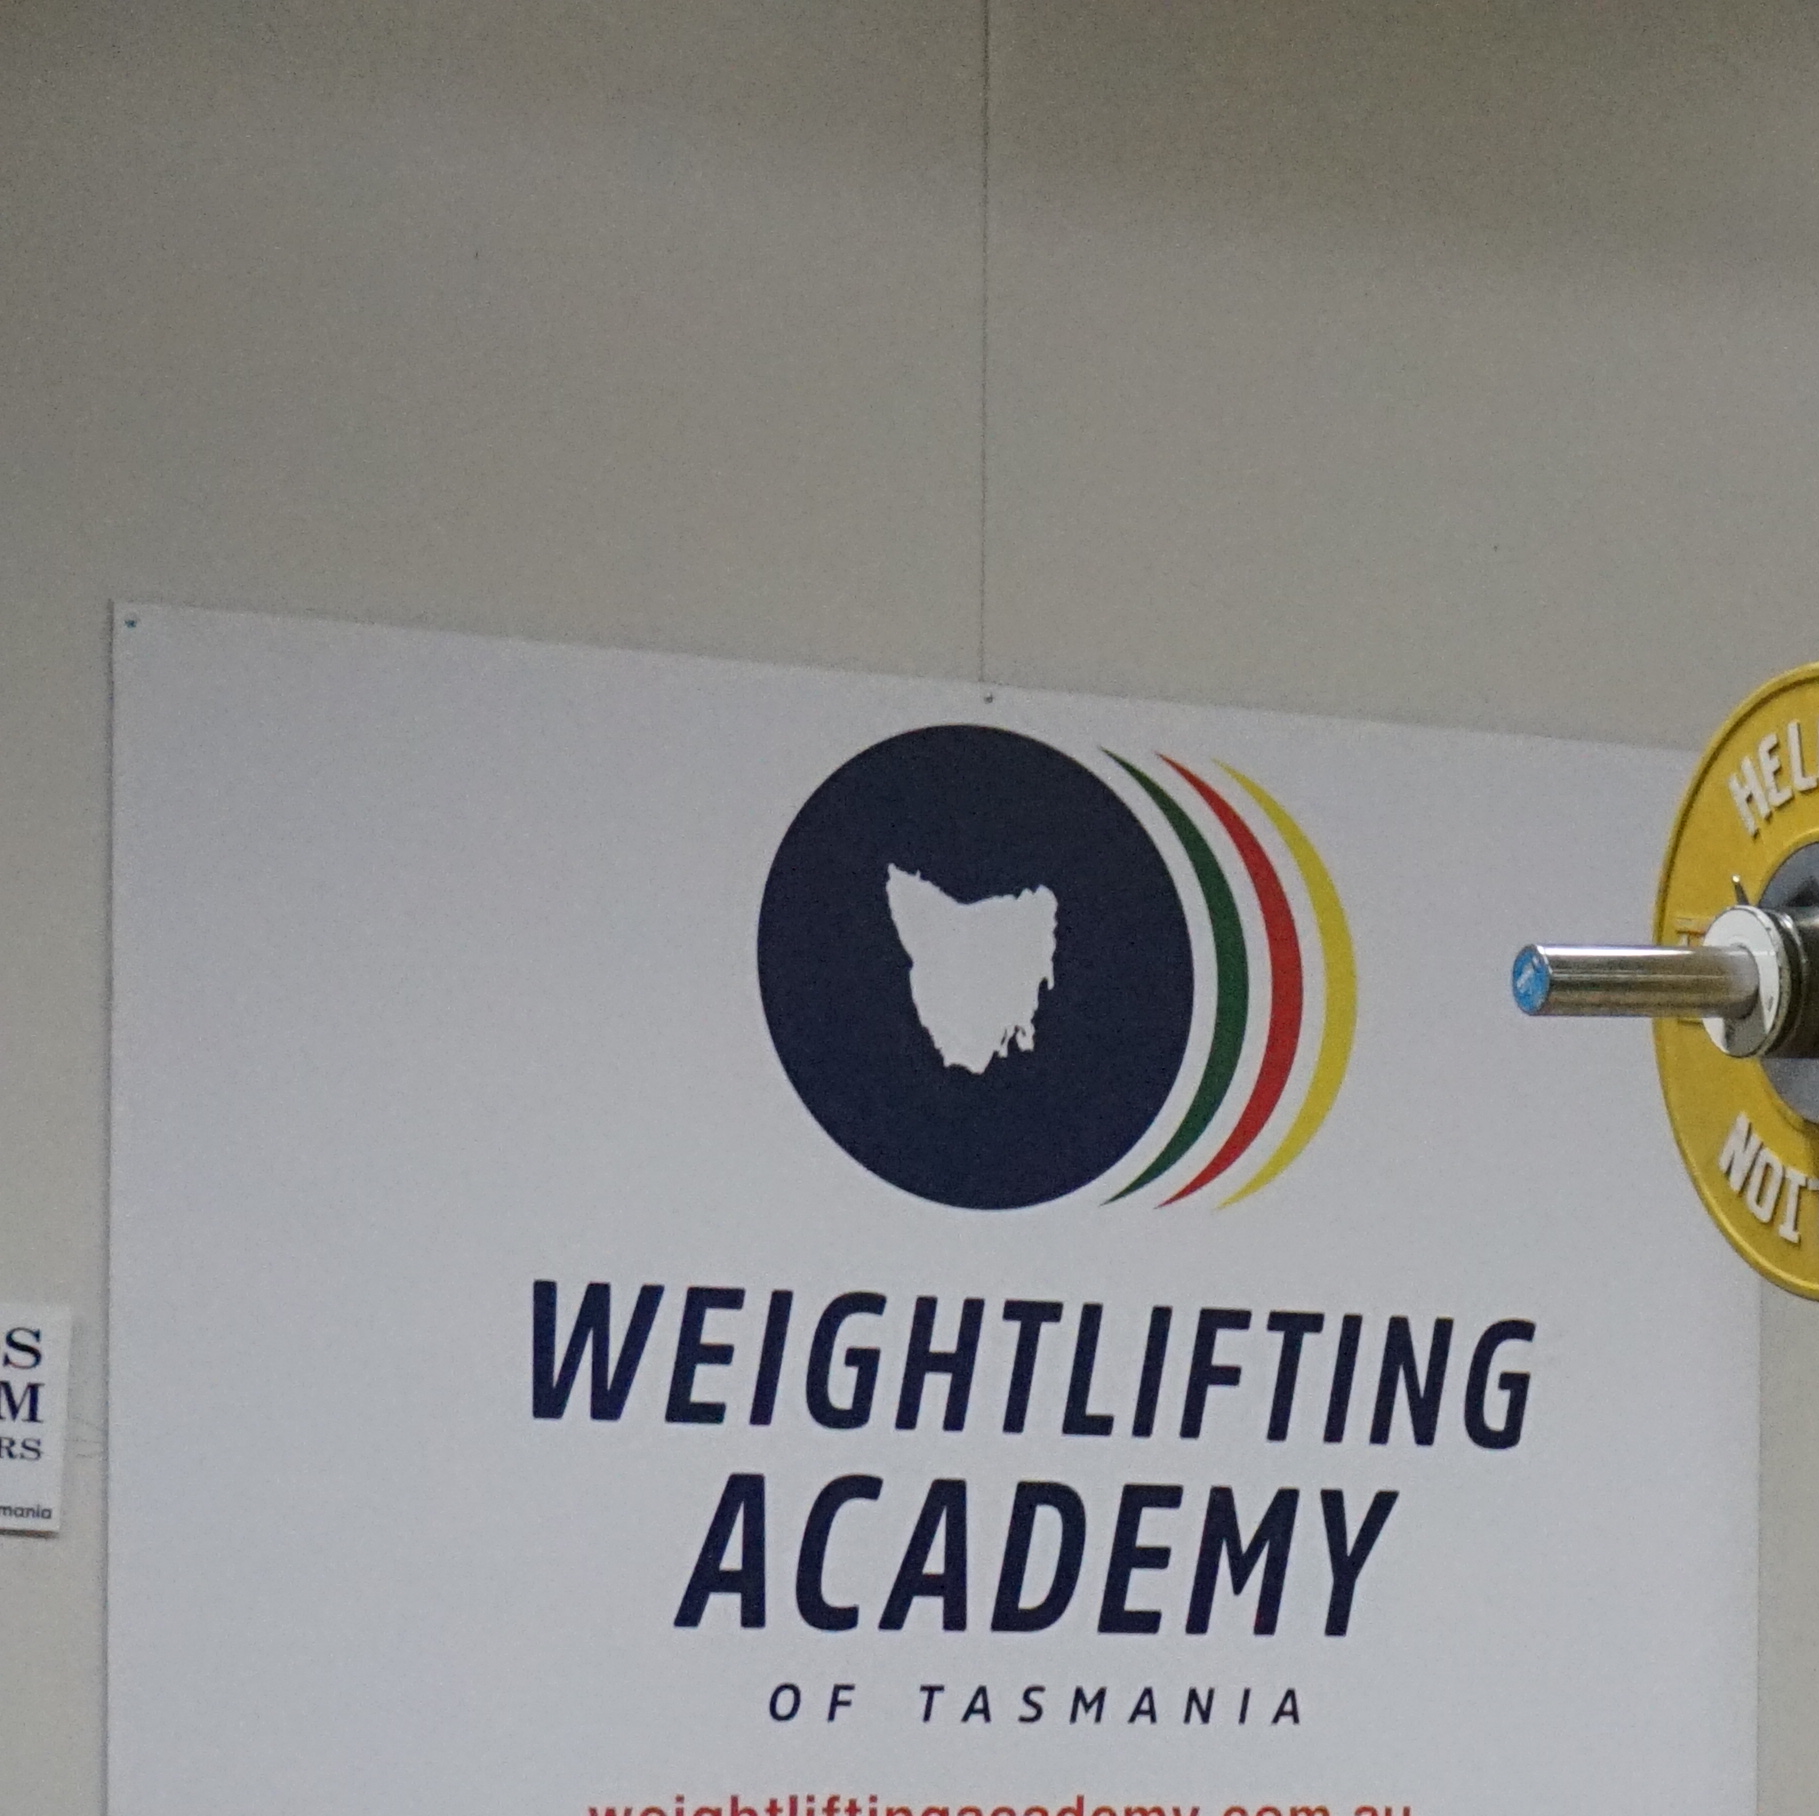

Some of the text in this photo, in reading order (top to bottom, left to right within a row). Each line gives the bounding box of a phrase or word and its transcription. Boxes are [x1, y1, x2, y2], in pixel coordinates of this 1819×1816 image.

[531, 1279, 1537, 1451] WEIGHTLIFTING
[673, 1472, 1401, 1639] ACADEMY
[767, 1681, 1306, 1726] OF TASMANIA
